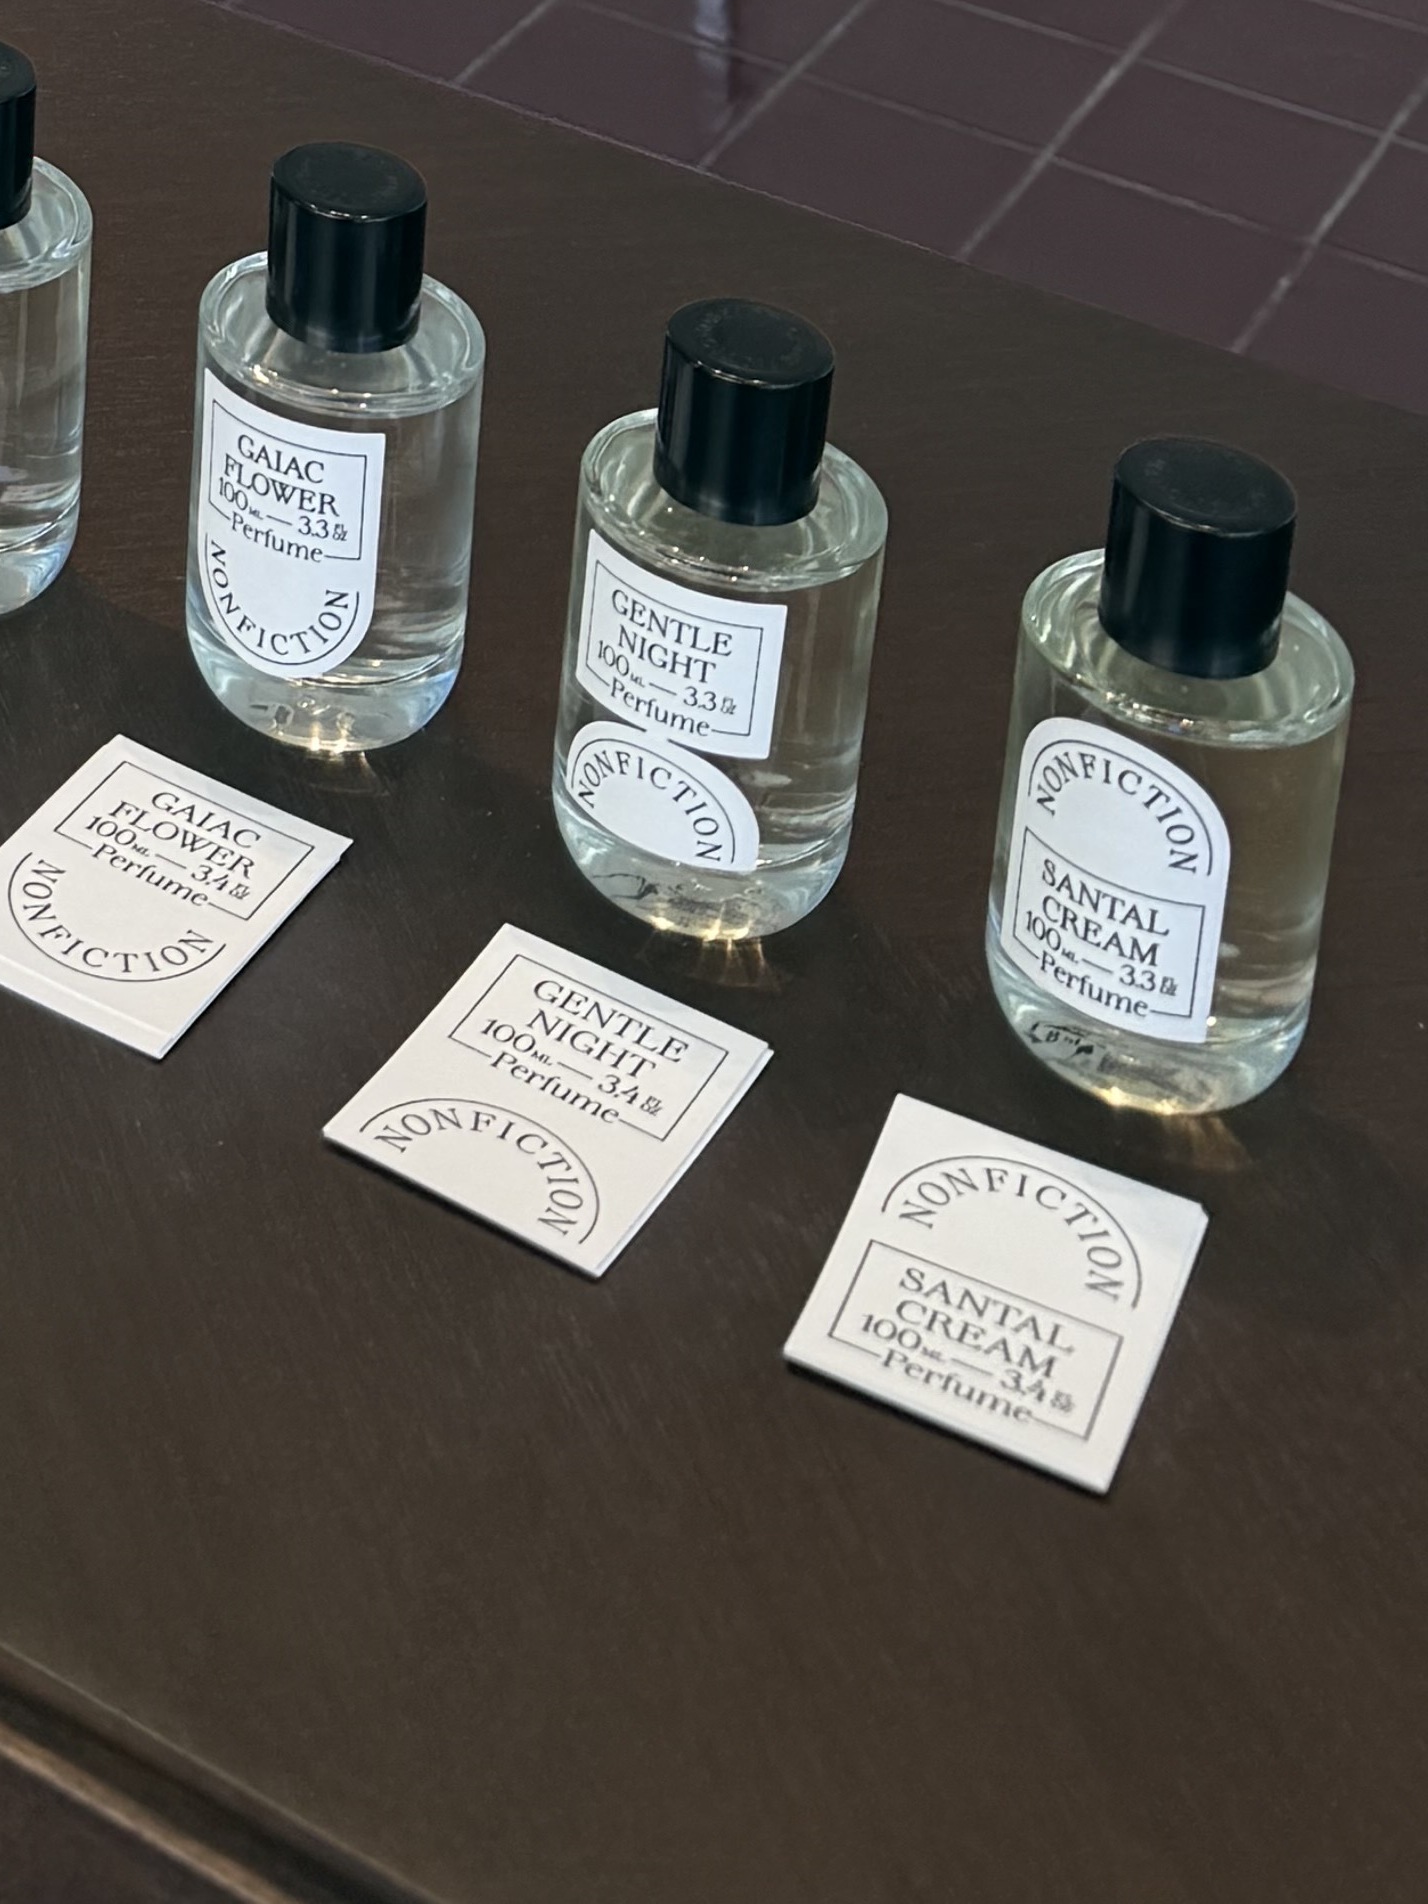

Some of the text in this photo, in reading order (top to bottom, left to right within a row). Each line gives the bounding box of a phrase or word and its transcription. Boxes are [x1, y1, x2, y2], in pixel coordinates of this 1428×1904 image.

[223, 453, 339, 517] FLOWER
[237, 434, 324, 484] GAIAC
[231, 511, 322, 563] Perfume
[298, 516, 329, 541] 3.3
[210, 539, 349, 656] NONFICTION
[612, 589, 732, 656] GENTLE
[618, 625, 716, 684] NIGHT
[610, 677, 710, 736] Perfume
[683, 686, 717, 711] 3.3
[108, 800, 256, 880] FLOWER
[151, 791, 262, 850] GAIAC
[578, 749, 722, 862] NONFICTION
[1036, 751, 1199, 874] NONFICTION
[92, 843, 209, 907] Perfume
[1042, 859, 1169, 936] SANTAL
[23, 859, 214, 974] NONFICTION
[1042, 895, 1160, 966] CREAM
[1039, 950, 1150, 1016] Perfume
[1119, 964, 1155, 993] 3.3
[527, 1010, 656, 1079] NIGHT
[533, 979, 689, 1062] GENTLE
[491, 1051, 620, 1123] Perfume
[598, 1075, 638, 1105] 3.4
[374, 1108, 583, 1236] NONFICTION
[899, 1167, 1124, 1302] NONFICTION
[896, 1299, 1058, 1379] CREAM
[899, 1267, 1074, 1353] SANTAL
[880, 1348, 1034, 1423] Perfume
